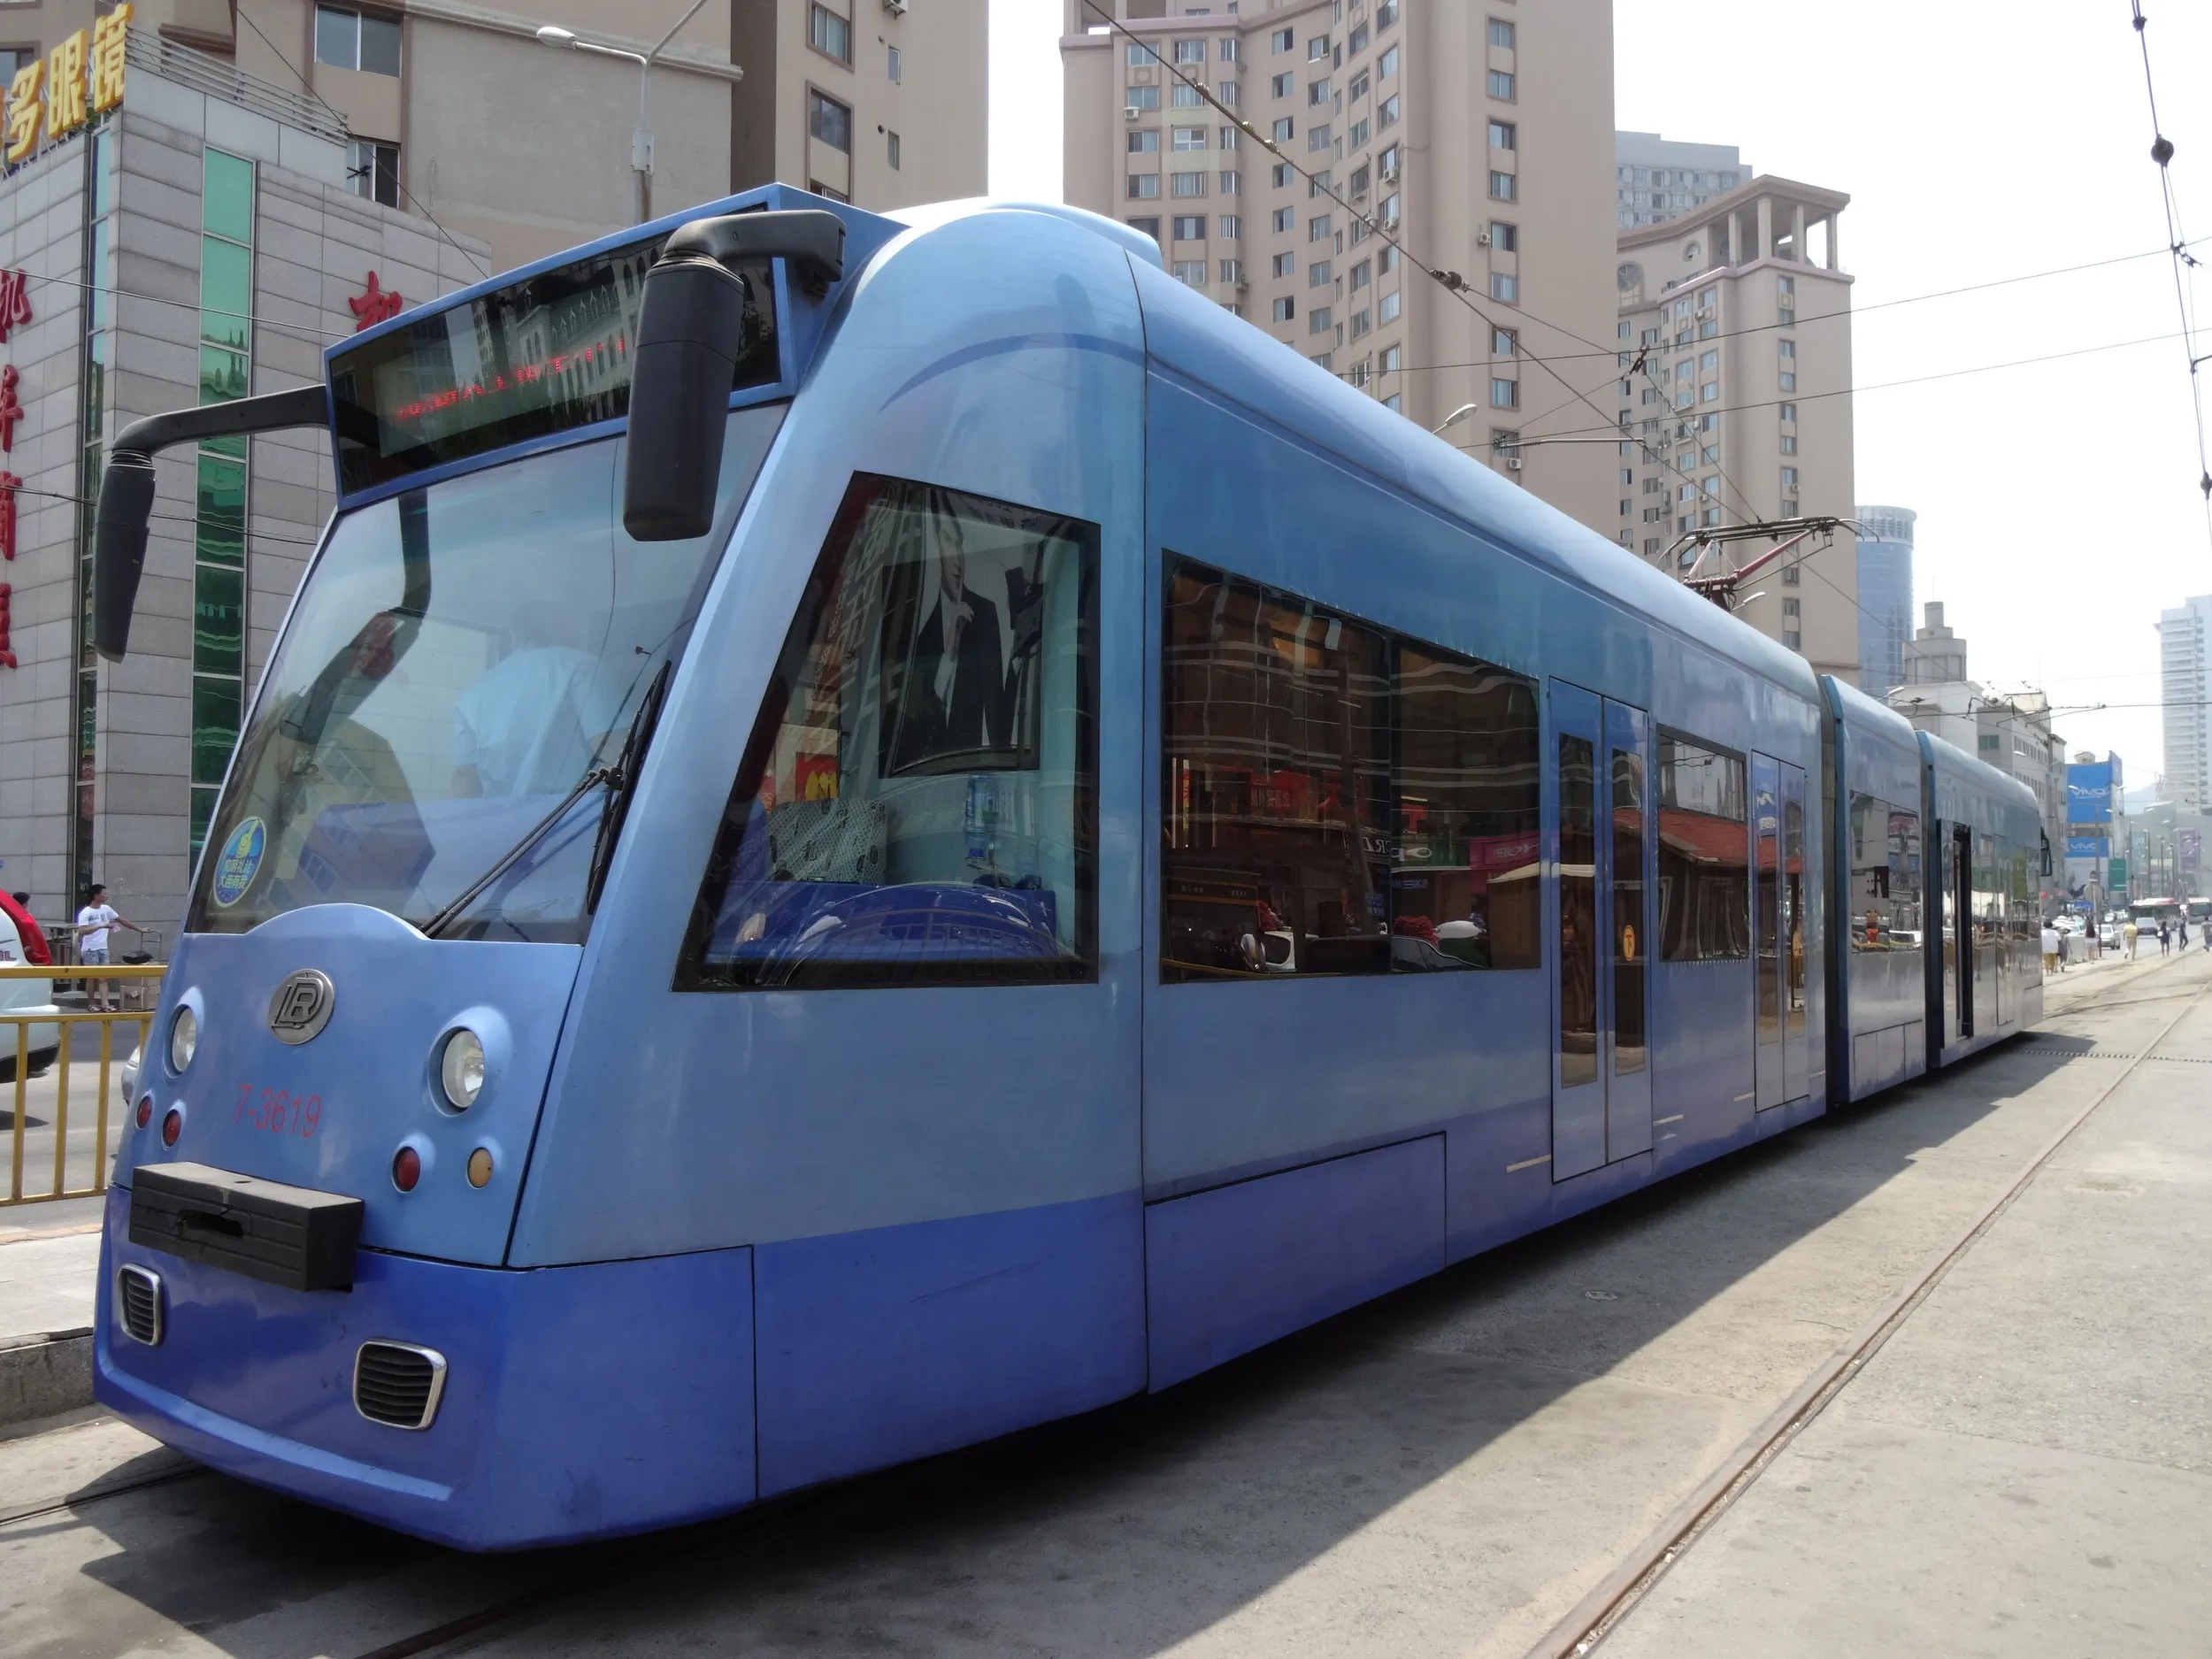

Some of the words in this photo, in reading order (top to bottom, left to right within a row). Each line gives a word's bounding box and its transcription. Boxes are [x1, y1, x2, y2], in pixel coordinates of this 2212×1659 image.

[0, 3, 134, 165] 多眼镜
[234, 1083, 322, 1139] 7-3619
